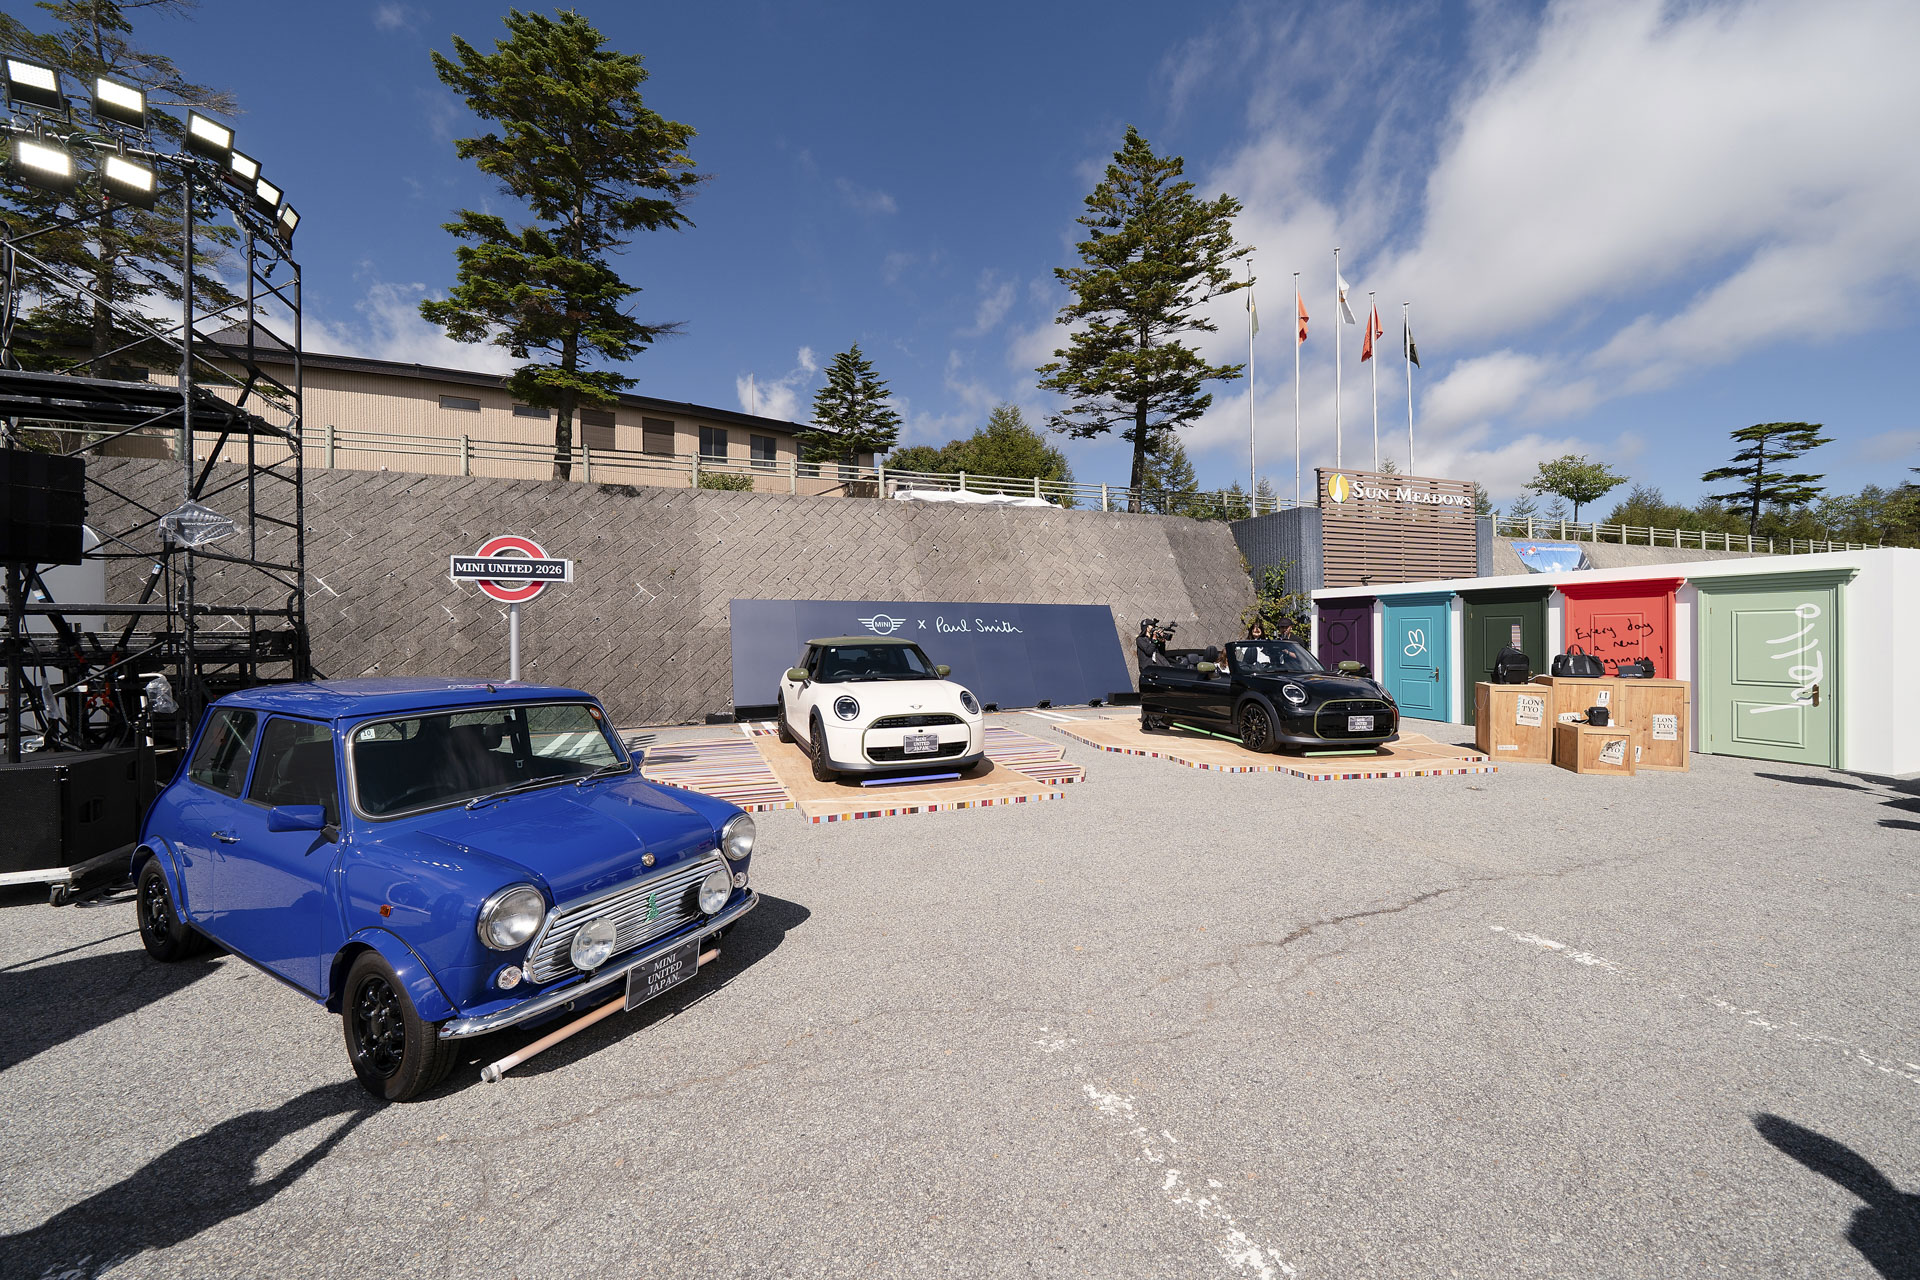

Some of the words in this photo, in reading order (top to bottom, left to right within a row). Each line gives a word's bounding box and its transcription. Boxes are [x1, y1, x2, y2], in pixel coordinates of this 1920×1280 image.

[455, 562, 485, 572] MINI
[488, 563, 533, 573] UNITED
[535, 565, 562, 574] 2026
[936, 616, 971, 633] Paul
[975, 618, 1023, 633] Smith
[1575, 626, 1617, 640] Every
[1627, 618, 1654, 637] day
[1613, 640, 1640, 648] new
[1521, 705, 1539, 713] TYO
[1522, 698, 1540, 706] LON
[653, 953, 677, 971] MINI
[647, 960, 682, 985] UNITED
